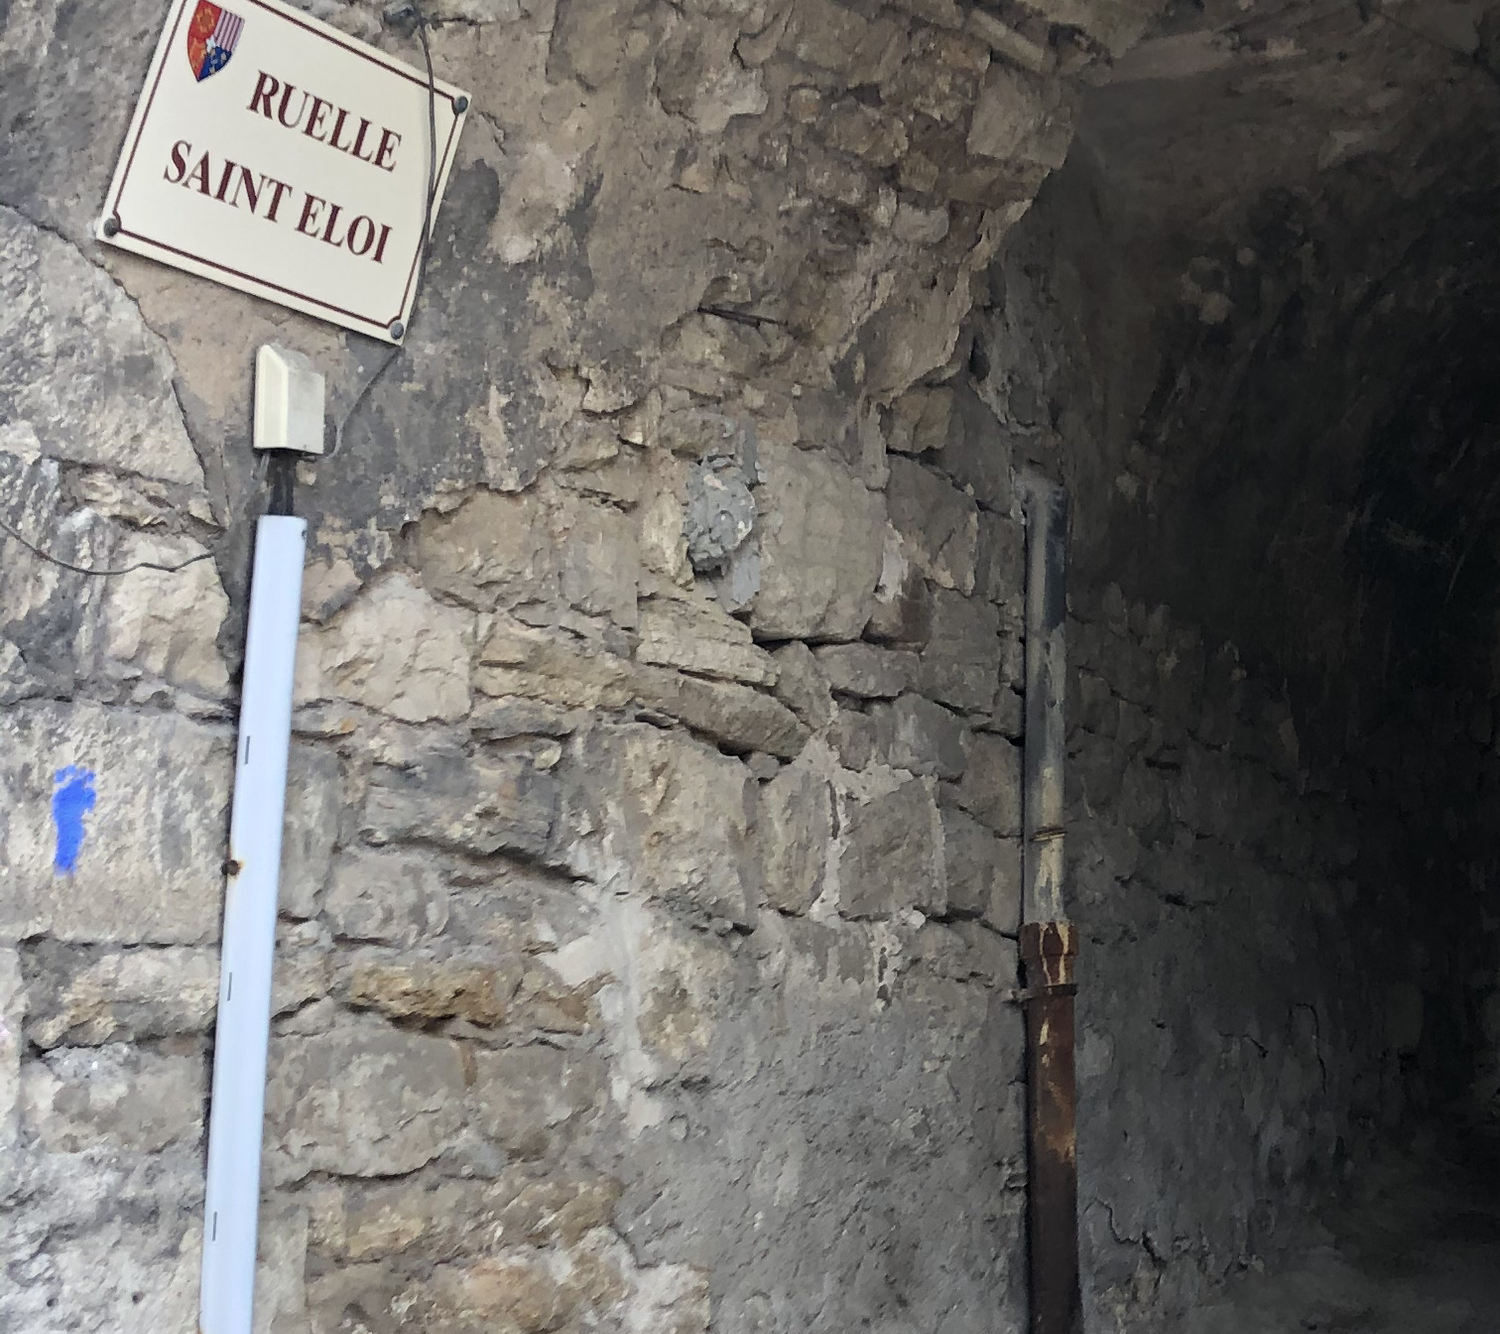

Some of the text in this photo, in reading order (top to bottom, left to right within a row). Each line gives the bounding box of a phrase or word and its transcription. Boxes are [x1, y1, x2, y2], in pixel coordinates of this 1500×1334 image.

[246, 70, 402, 172] RUELLE
[163, 140, 393, 265] SAINT ELOI
